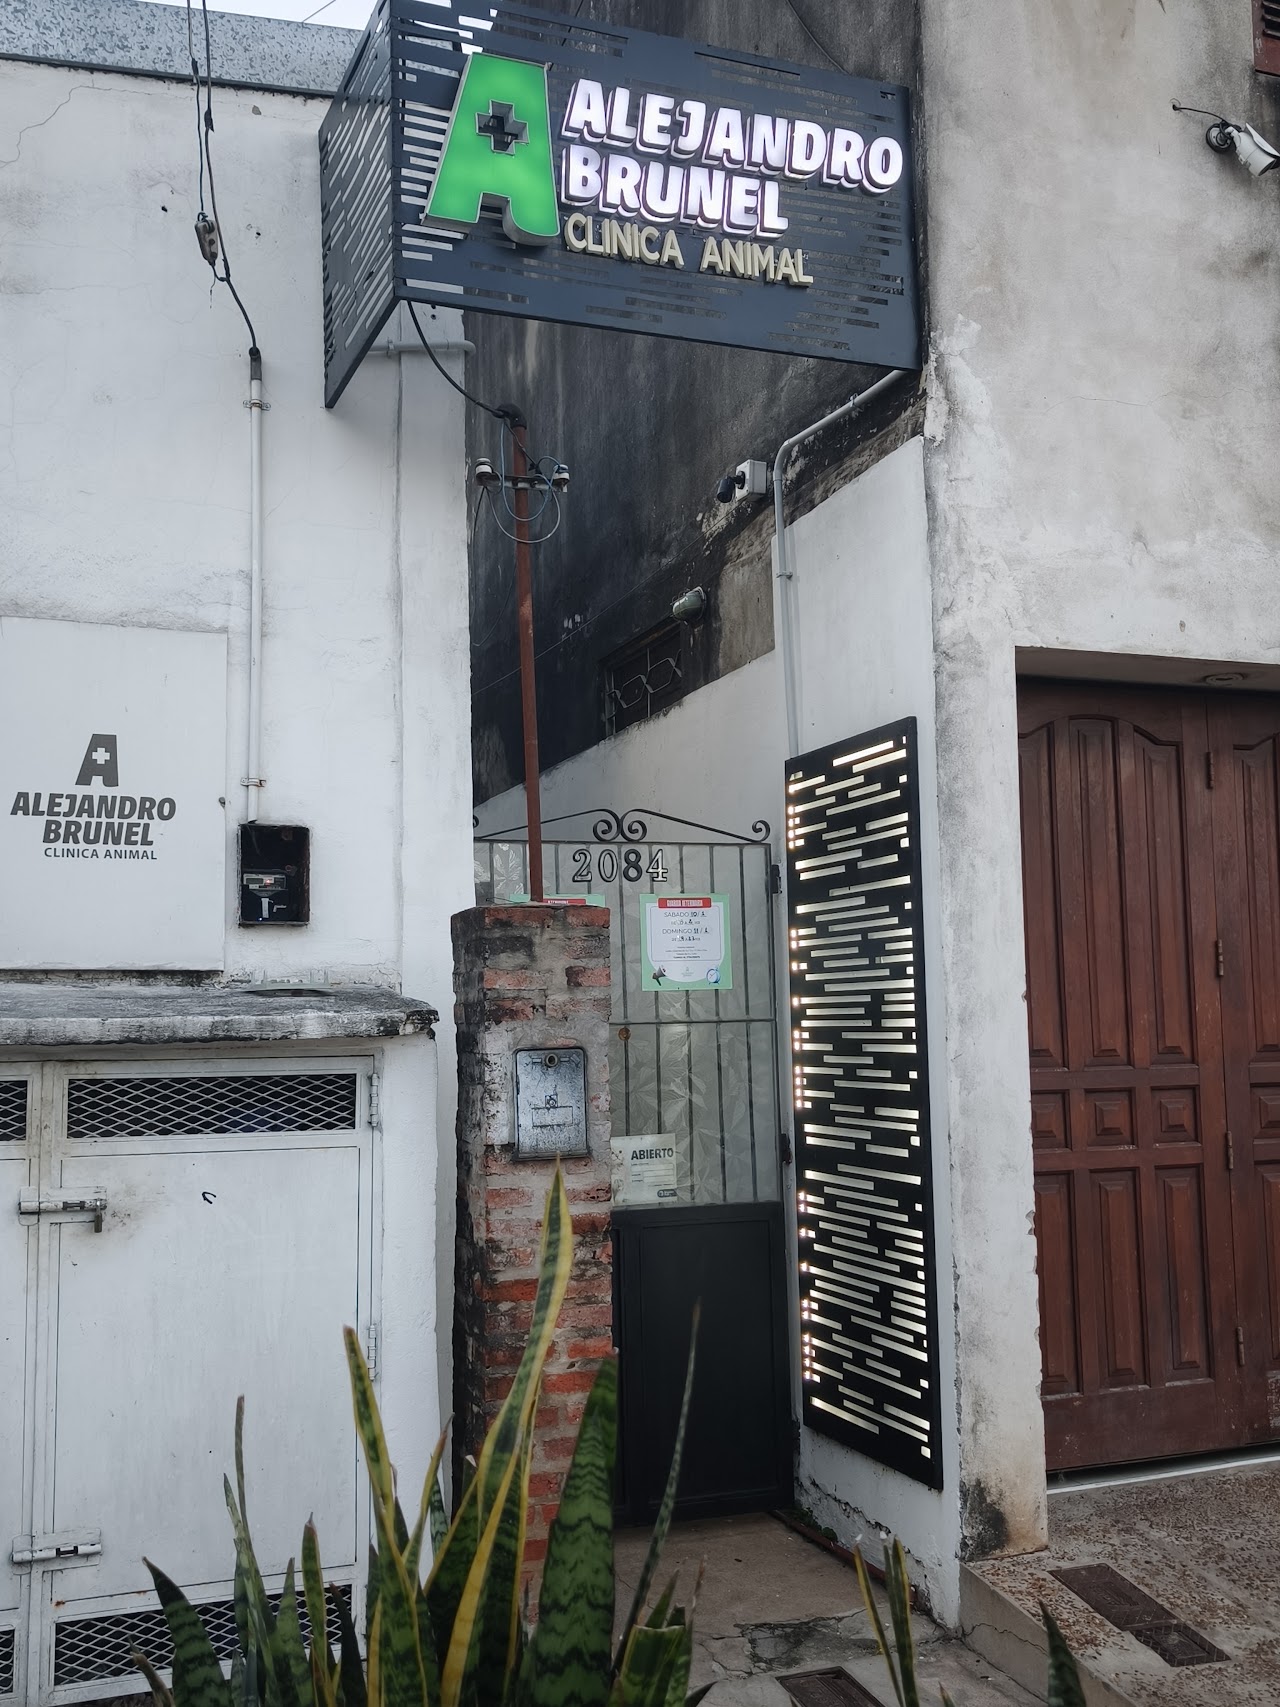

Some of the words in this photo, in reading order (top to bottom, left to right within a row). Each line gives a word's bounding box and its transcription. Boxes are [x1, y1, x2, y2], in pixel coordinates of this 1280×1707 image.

[562, 78, 903, 194] ALEJANDRO
[561, 144, 789, 238] BRUNEL
[564, 213, 684, 268] CLINICA
[699, 237, 814, 287] ANIMAL
[10, 791, 177, 821] ALEJANDRO
[42, 819, 154, 846] BRUNEL
[44, 847, 99, 859] CLINICA
[103, 849, 157, 860] ANIMAL
[572, 848, 669, 882] 2084
[631, 1147, 674, 1160] ABIERTO
